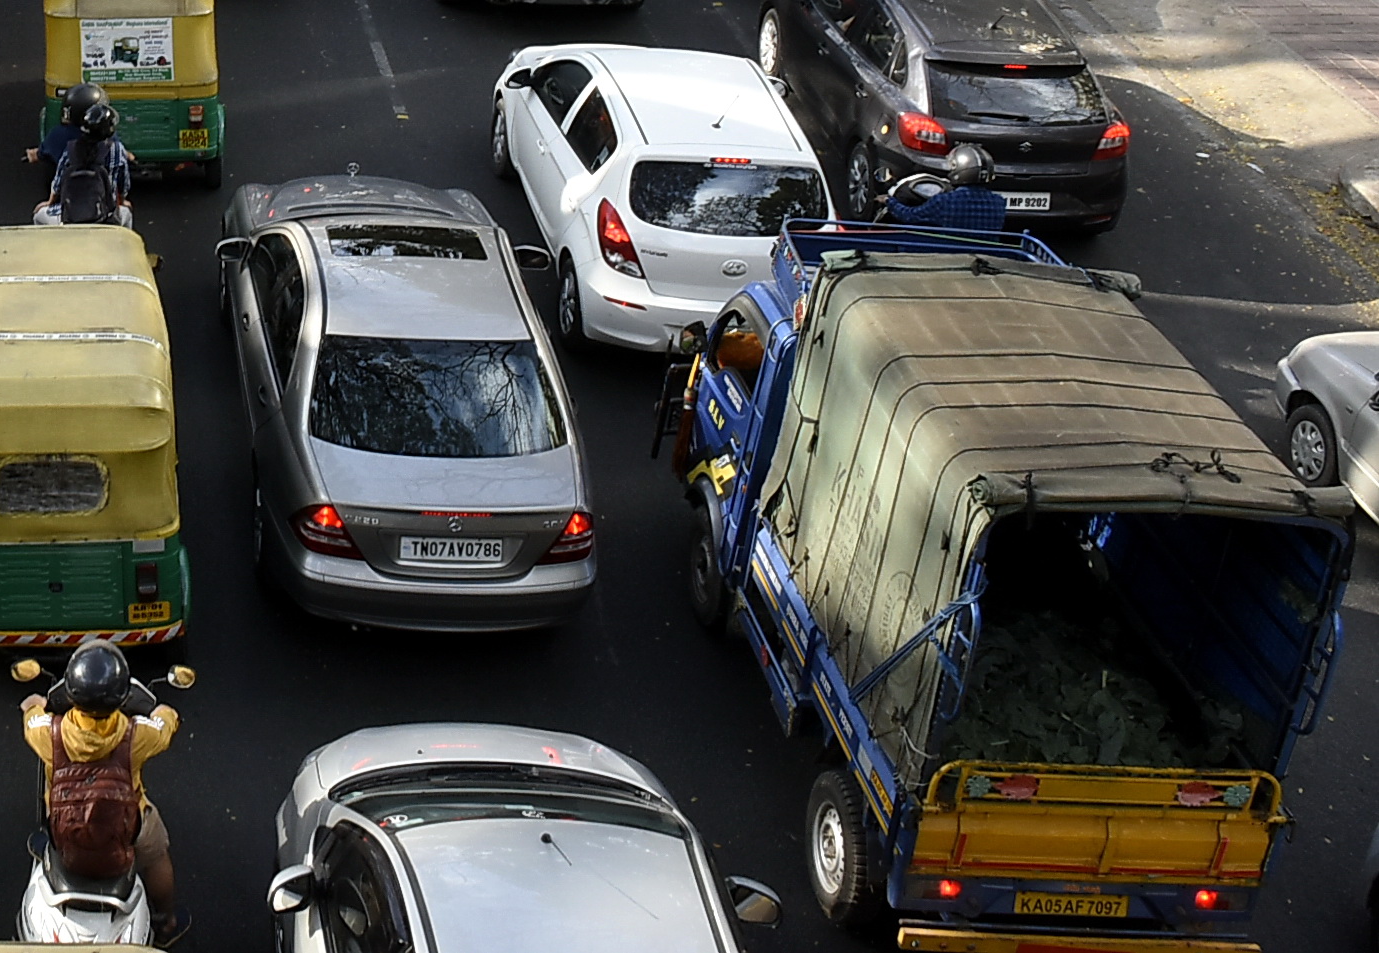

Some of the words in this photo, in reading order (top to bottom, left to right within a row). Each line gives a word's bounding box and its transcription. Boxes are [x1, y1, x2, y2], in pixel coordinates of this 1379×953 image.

[1009, 197, 1023, 207] MP
[1024, 197, 1048, 207] 9202
[411, 541, 501, 557] TN07AV0786
